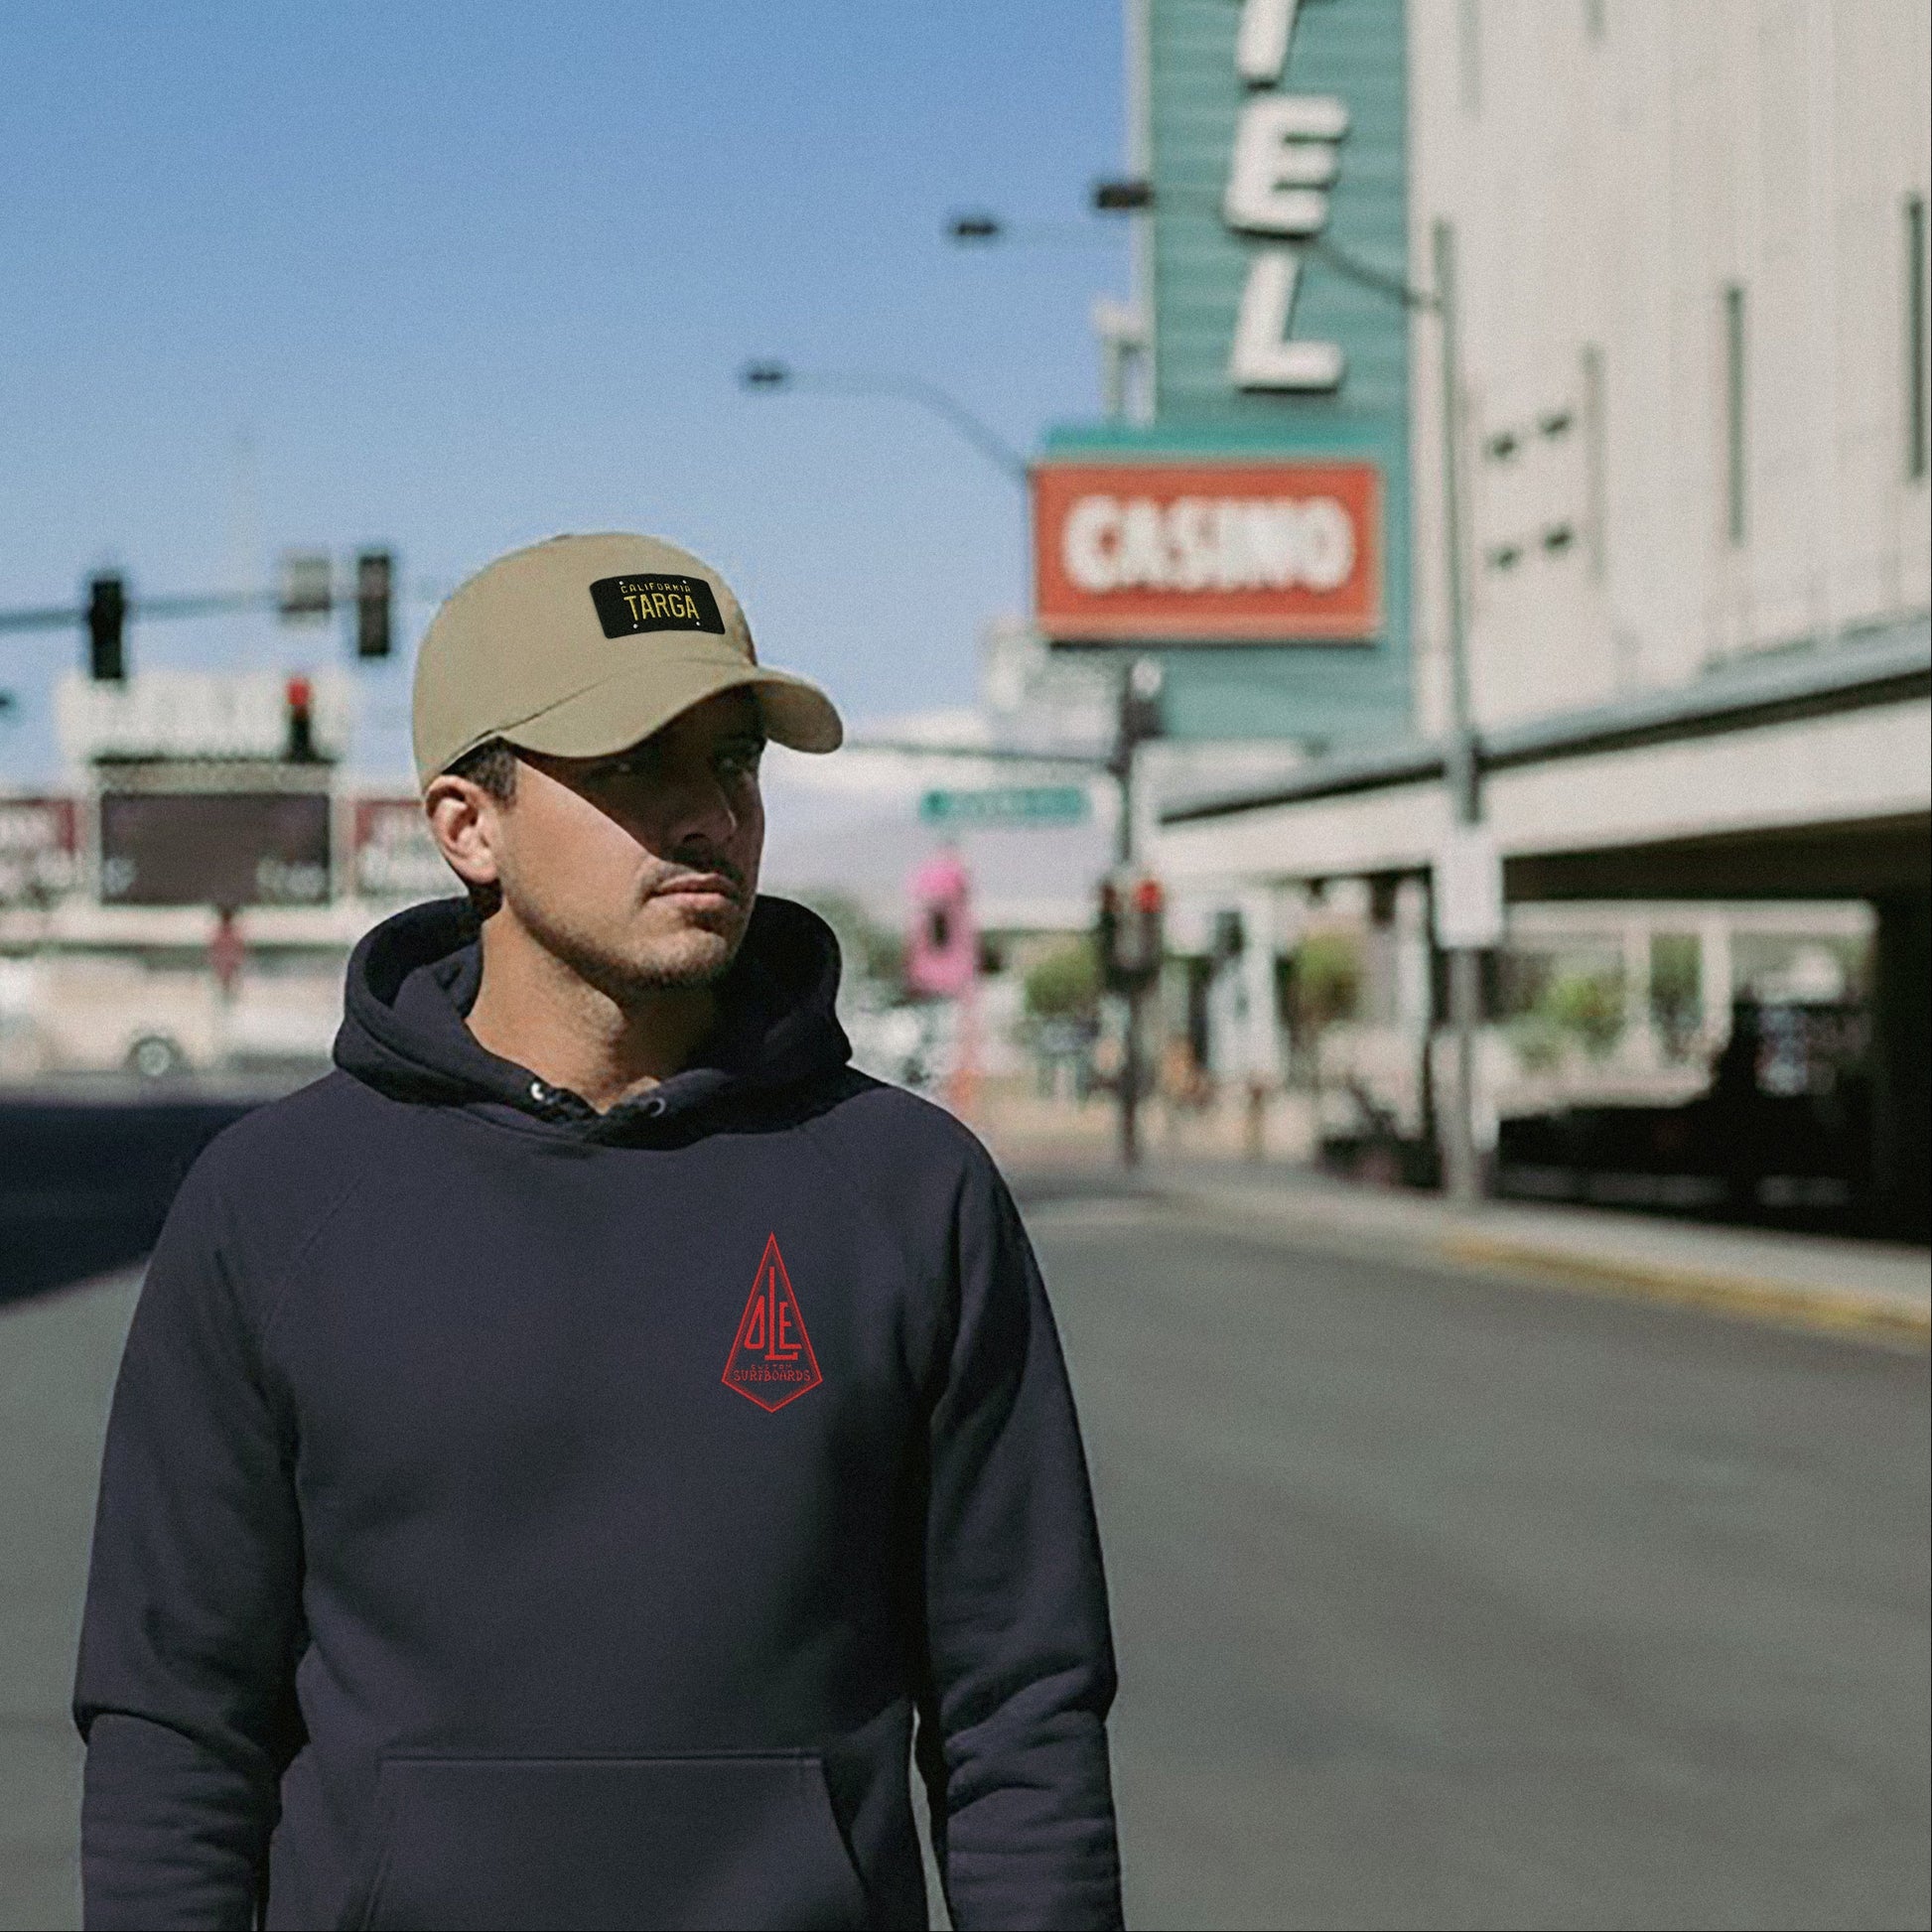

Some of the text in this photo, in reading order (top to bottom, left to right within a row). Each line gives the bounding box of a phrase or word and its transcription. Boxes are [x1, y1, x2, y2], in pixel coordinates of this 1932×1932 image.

[1062, 494, 1355, 596] CASINO
[621, 582, 692, 594] CALIFORNIA
[623, 593, 700, 621] TARGA
[733, 1369, 812, 1382] SURFBOARDS
